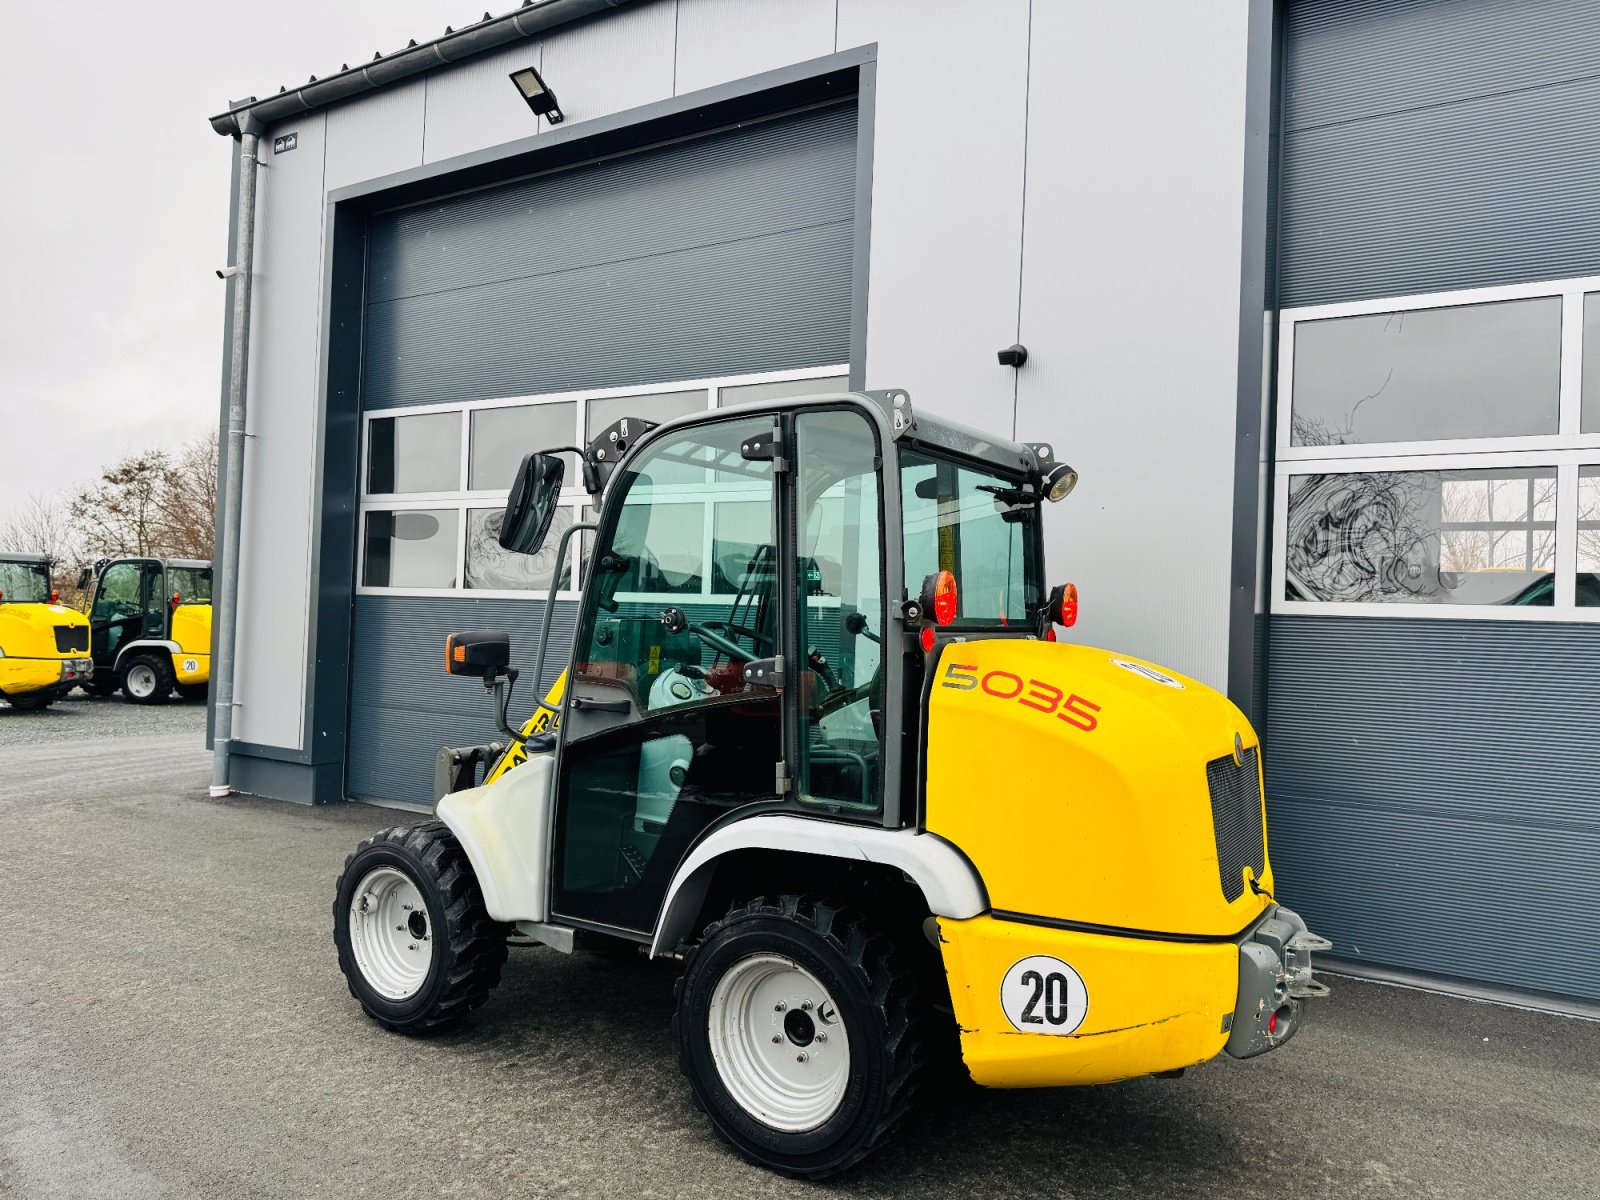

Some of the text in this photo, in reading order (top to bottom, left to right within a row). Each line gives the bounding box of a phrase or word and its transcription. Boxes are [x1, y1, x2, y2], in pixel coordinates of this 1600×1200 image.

[186, 660, 196, 671] 20
[942, 663, 1102, 732] 5035
[1021, 970, 1068, 1026] 20
